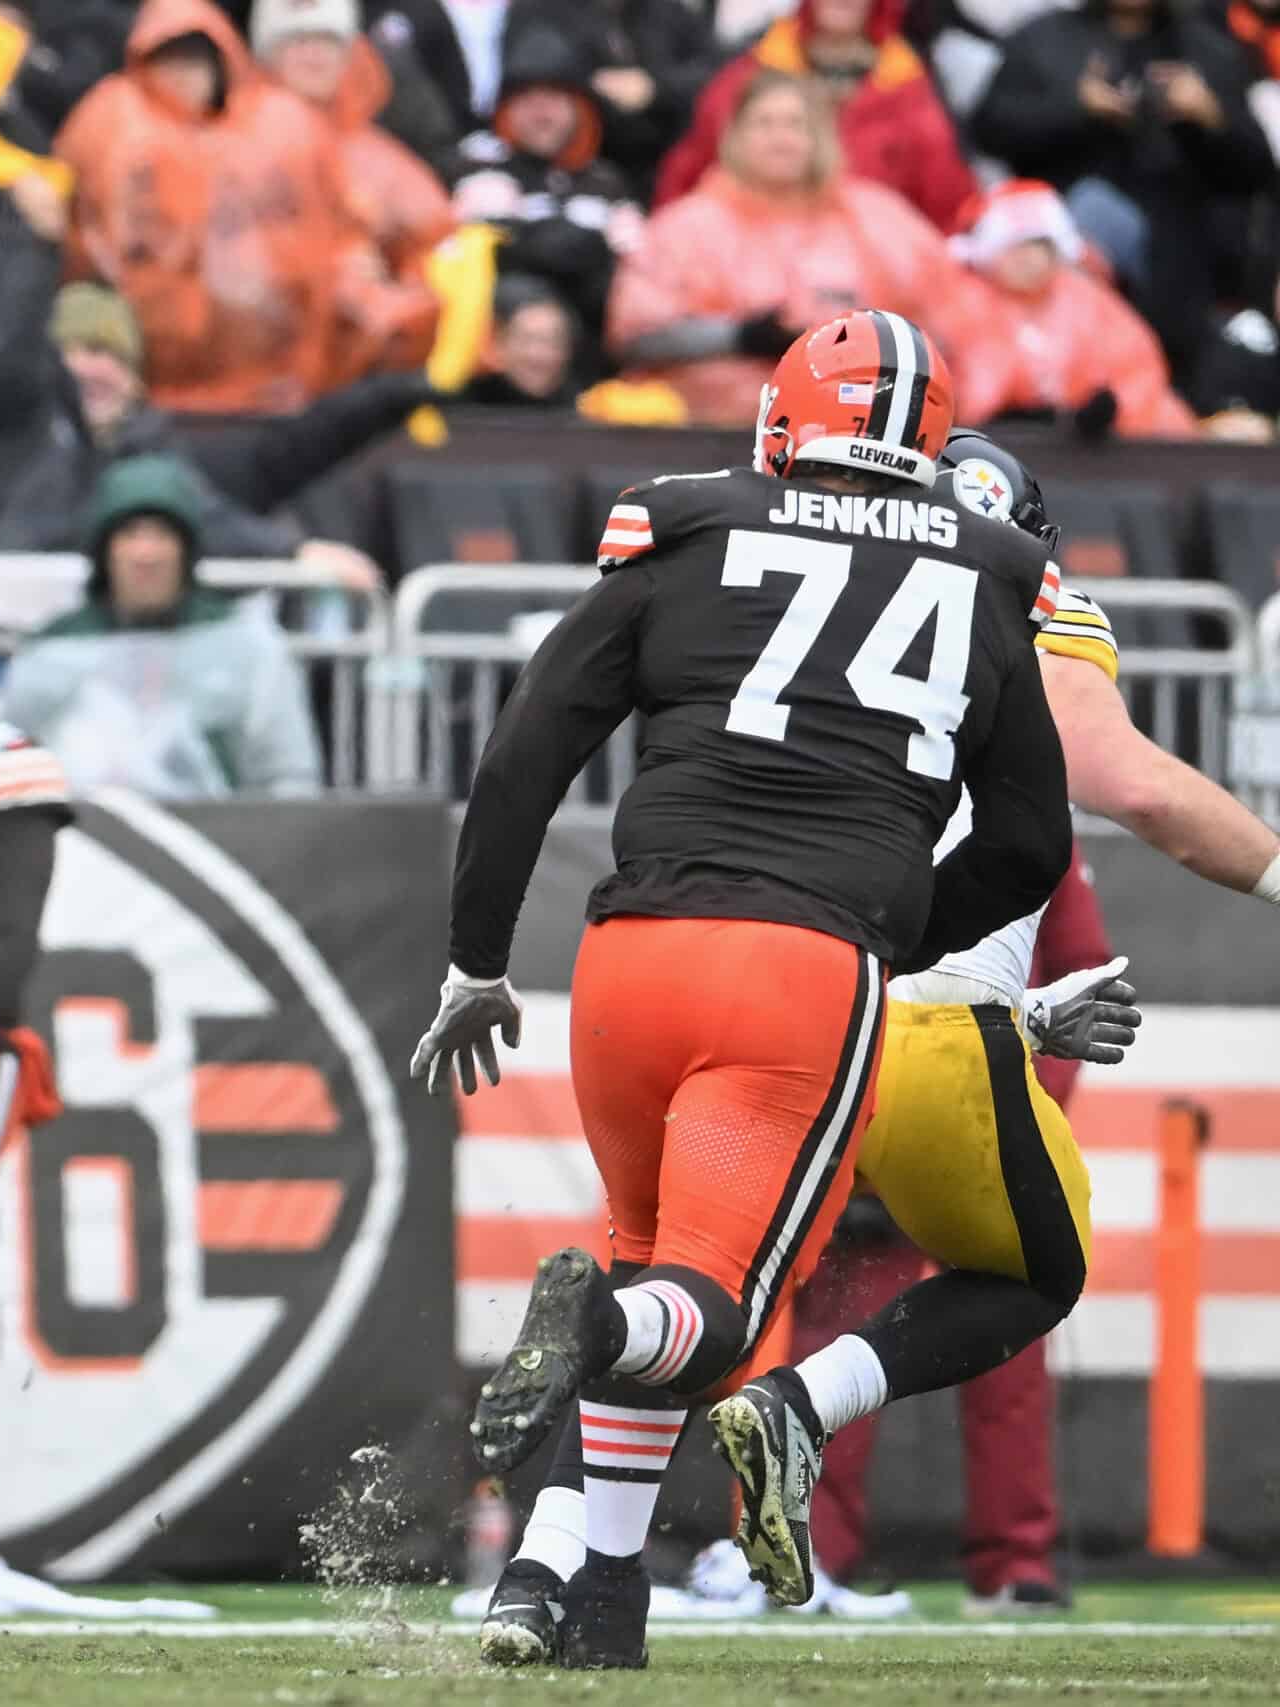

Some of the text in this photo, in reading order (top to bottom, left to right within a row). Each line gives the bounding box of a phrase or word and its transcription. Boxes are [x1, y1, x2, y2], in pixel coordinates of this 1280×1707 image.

[849, 444, 919, 475] CLEVELAND
[768, 488, 958, 548] JENKINS
[720, 528, 979, 782] 74
